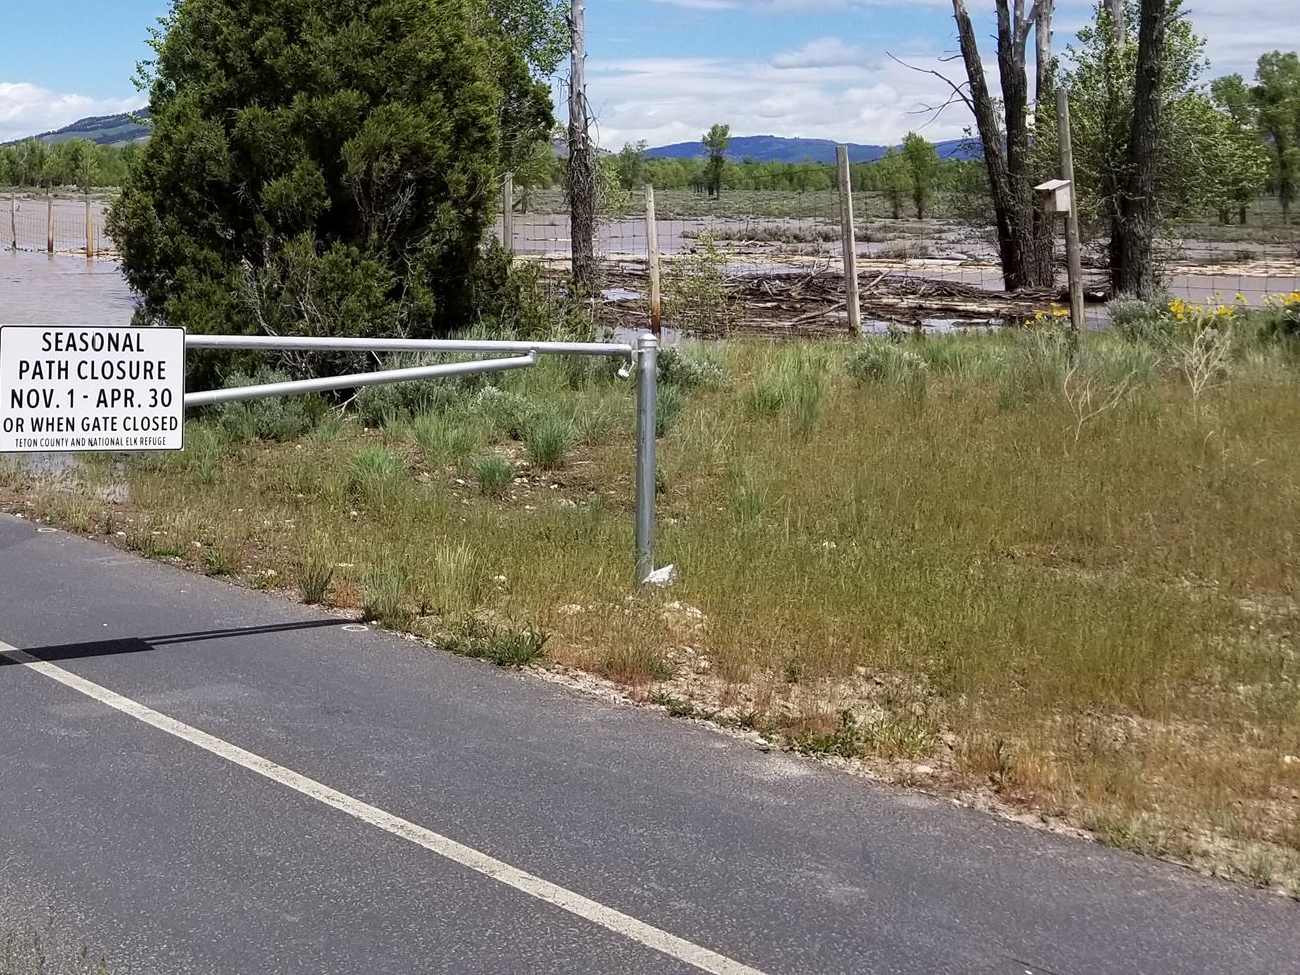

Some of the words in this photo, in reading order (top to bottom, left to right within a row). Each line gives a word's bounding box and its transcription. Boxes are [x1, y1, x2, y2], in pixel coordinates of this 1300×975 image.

[41, 332, 145, 352] SEASONAL
[18, 360, 69, 380] PATH
[76, 360, 166, 380] CLOSURE
[10, 388, 60, 409] NOV.
[67, 388, 74, 408] 1
[95, 388, 142, 408] APR.
[148, 388, 172, 408] 30
[3, 417, 25, 432] OR
[30, 416, 75, 432] WHEN
[81, 416, 118, 432] GATE
[122, 416, 178, 432] CLOSED
[15, 438, 38, 447] TETON
[39, 437, 69, 447] COUNTY
[70, 437, 86, 447] AND
[87, 437, 124, 447] NATIONAL
[125, 436, 138, 446] ELK
[139, 436, 166, 446] REFUGE
